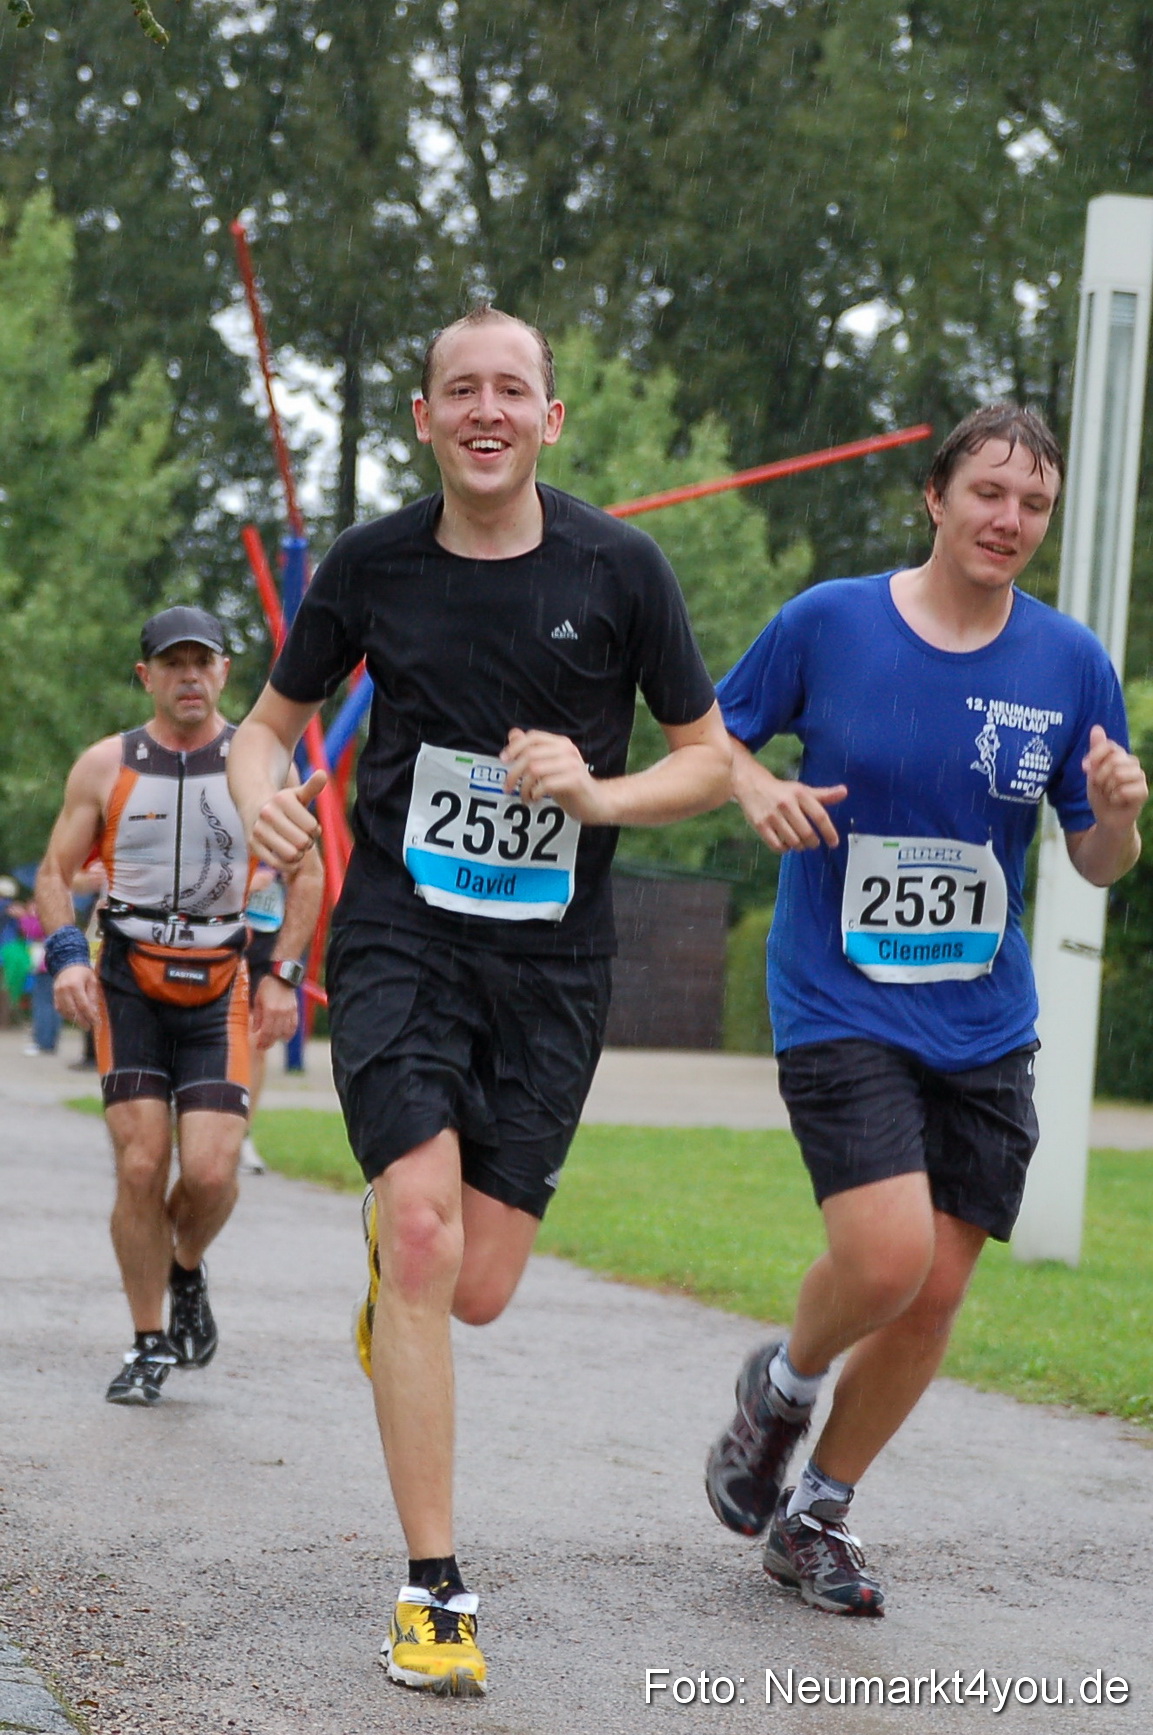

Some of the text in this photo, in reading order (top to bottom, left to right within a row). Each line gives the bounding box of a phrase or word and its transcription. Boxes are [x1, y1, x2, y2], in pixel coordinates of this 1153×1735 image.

[966, 696, 1063, 726] 12. NEUMARKTER
[986, 710, 1049, 734] STADTLAUF
[424, 790, 565, 862] 2532
[456, 867, 517, 896] David
[860, 875, 987, 927] 2531
[878, 939, 964, 961] Clemens
